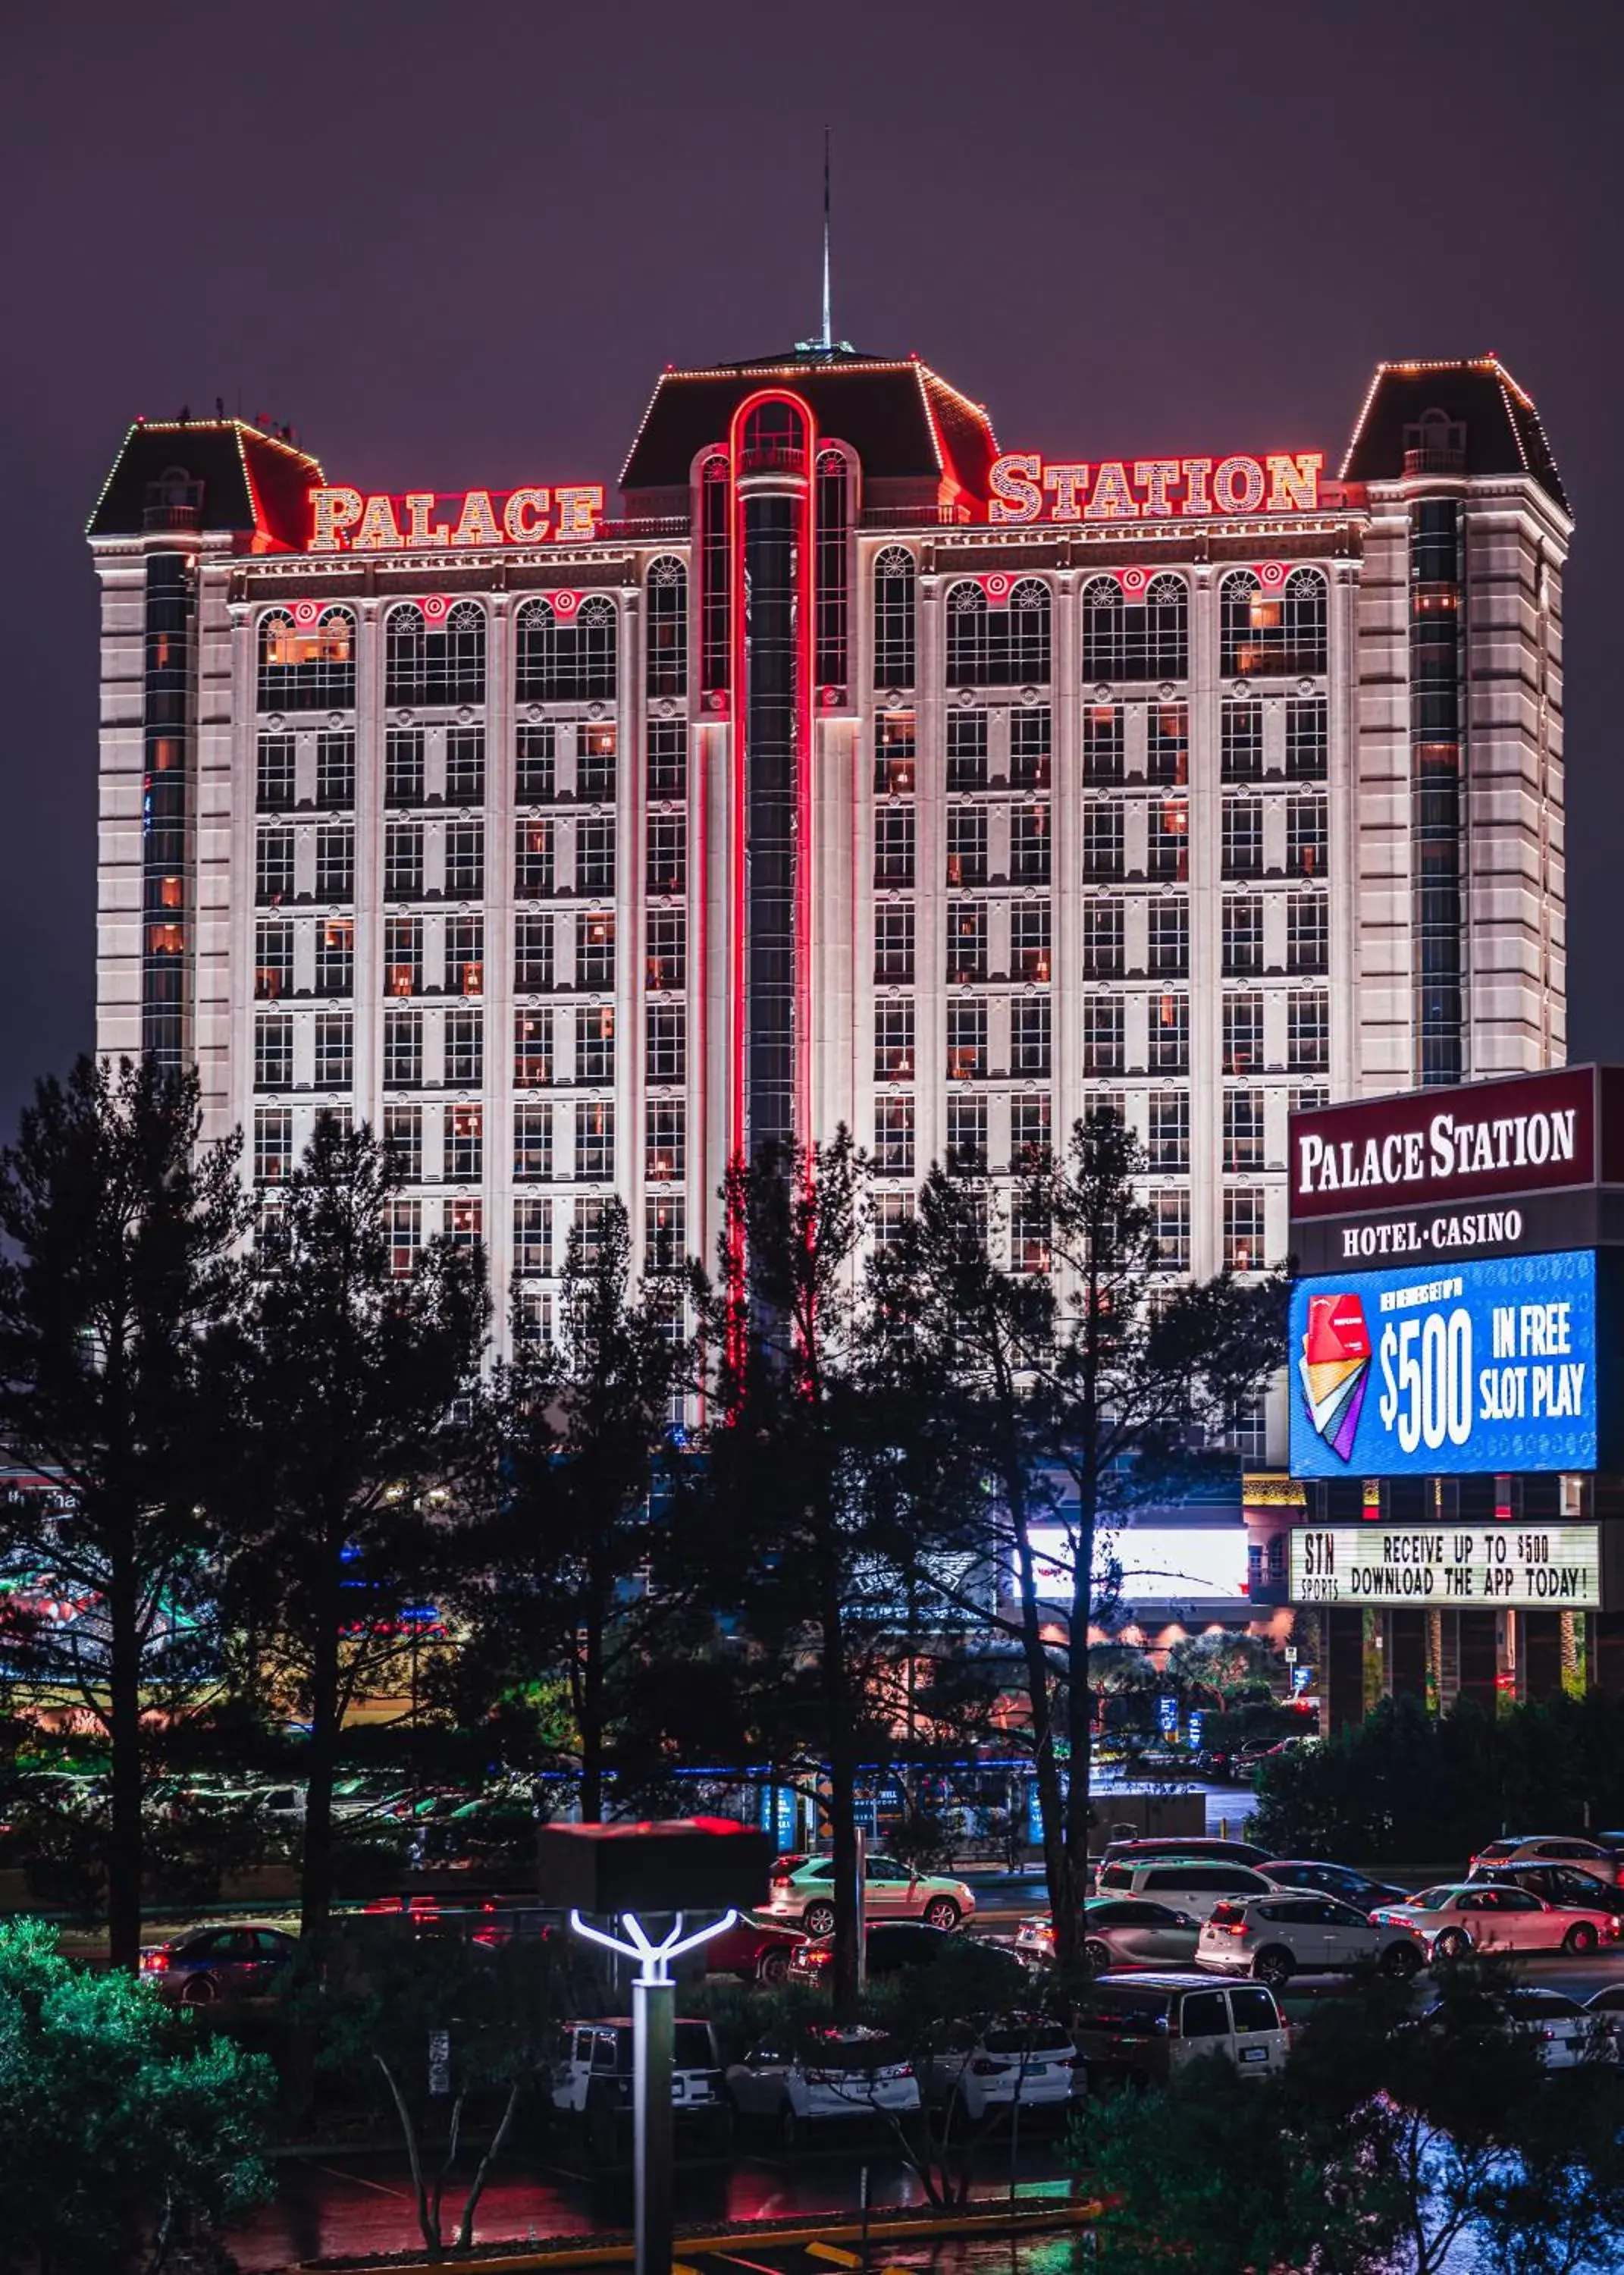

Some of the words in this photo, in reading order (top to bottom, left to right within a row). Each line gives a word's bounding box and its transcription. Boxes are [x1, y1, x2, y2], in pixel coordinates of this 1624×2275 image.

[307, 486, 603, 551] PALACE
[988, 453, 1323, 522] STATION
[1299, 1132, 1425, 1193] PALACE
[1430, 1109, 1576, 1178] STATION
[1493, 1307, 1511, 1358] IN
[1520, 1302, 1570, 1357] FREE
[1379, 1308, 1473, 1454] $500
[1480, 1367, 1528, 1420] SLOT
[1532, 1364, 1585, 1417] PLAY
[1305, 1533, 1334, 1575] STN
[1384, 1536, 1444, 1563] RECEIVE
[1455, 1536, 1473, 1563] UP
[1484, 1536, 1506, 1564] TO
[1518, 1535, 1548, 1563] $500
[1302, 1579, 1339, 1601] SPORTS
[1352, 1567, 1434, 1595] DOWNLOAD
[1445, 1568, 1472, 1596] THE
[1484, 1568, 1514, 1596] APP
[1526, 1568, 1587, 1599] TODAY!
